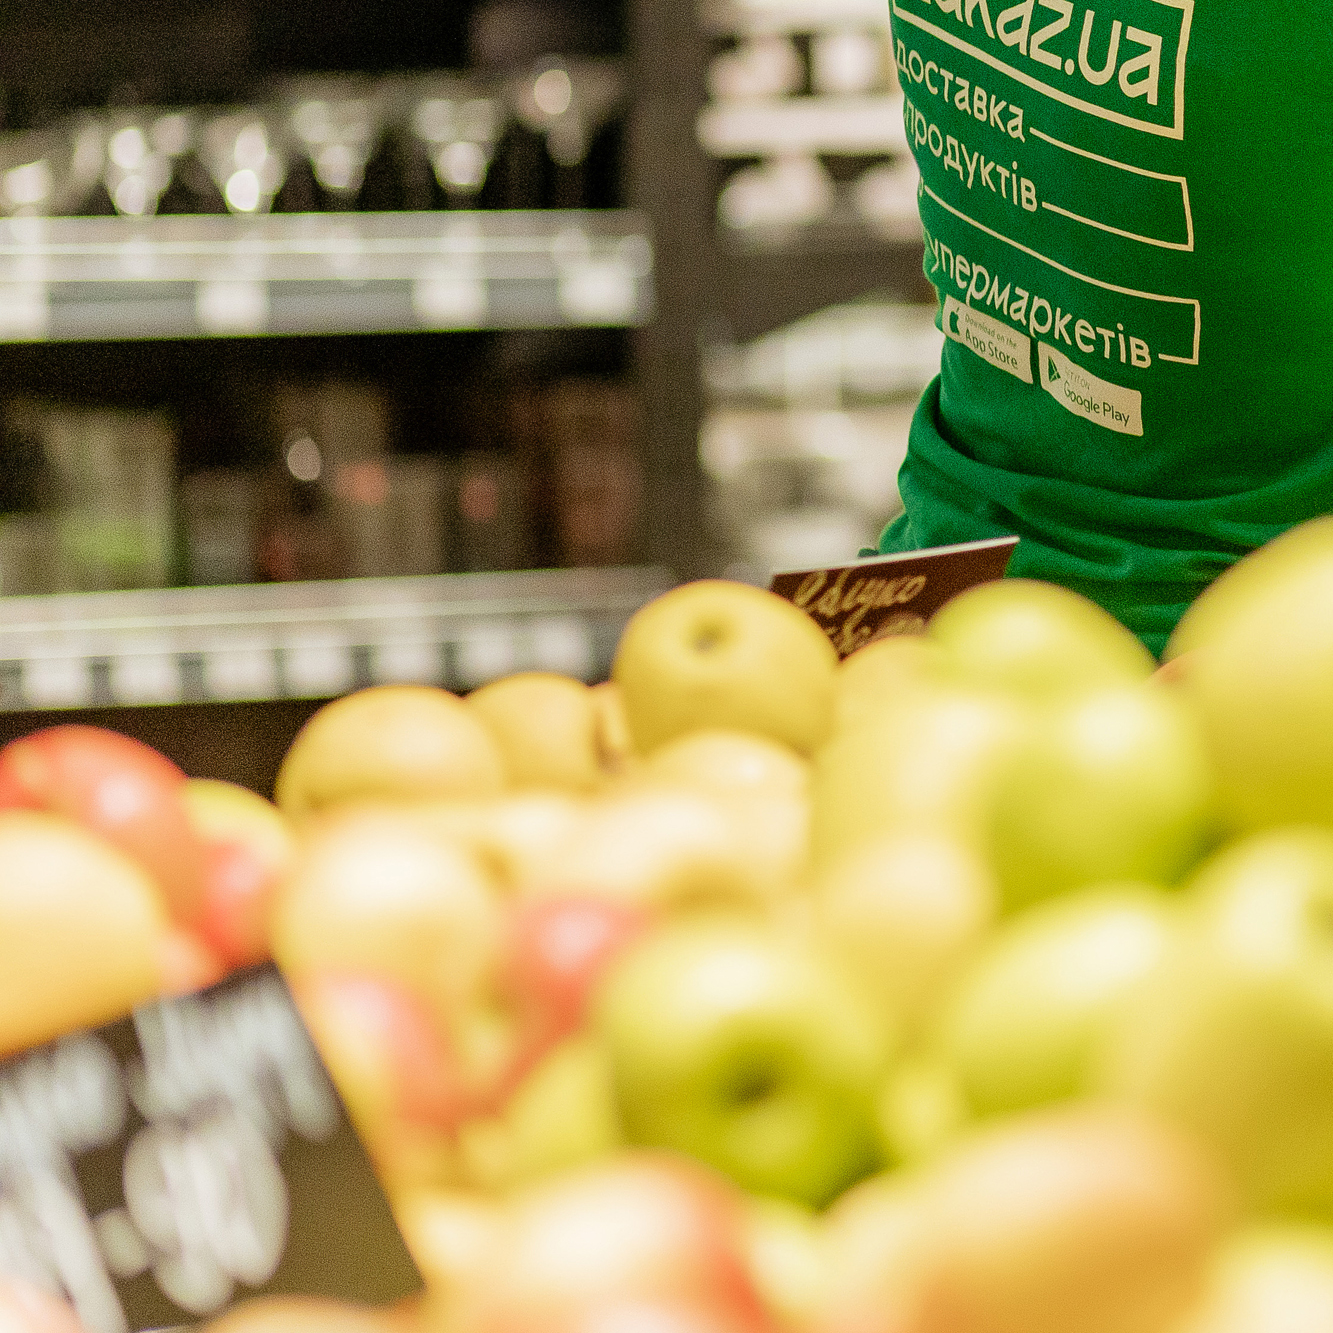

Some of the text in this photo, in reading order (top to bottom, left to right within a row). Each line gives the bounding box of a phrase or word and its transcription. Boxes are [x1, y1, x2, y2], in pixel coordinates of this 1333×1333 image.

[897, 38, 1026, 143] доставка
[905, 97, 1038, 212] продуктів
[925, 230, 1152, 369] упермаркетів
[965, 328, 1019, 370] App Store
[1063, 380, 1130, 427] Google Play
